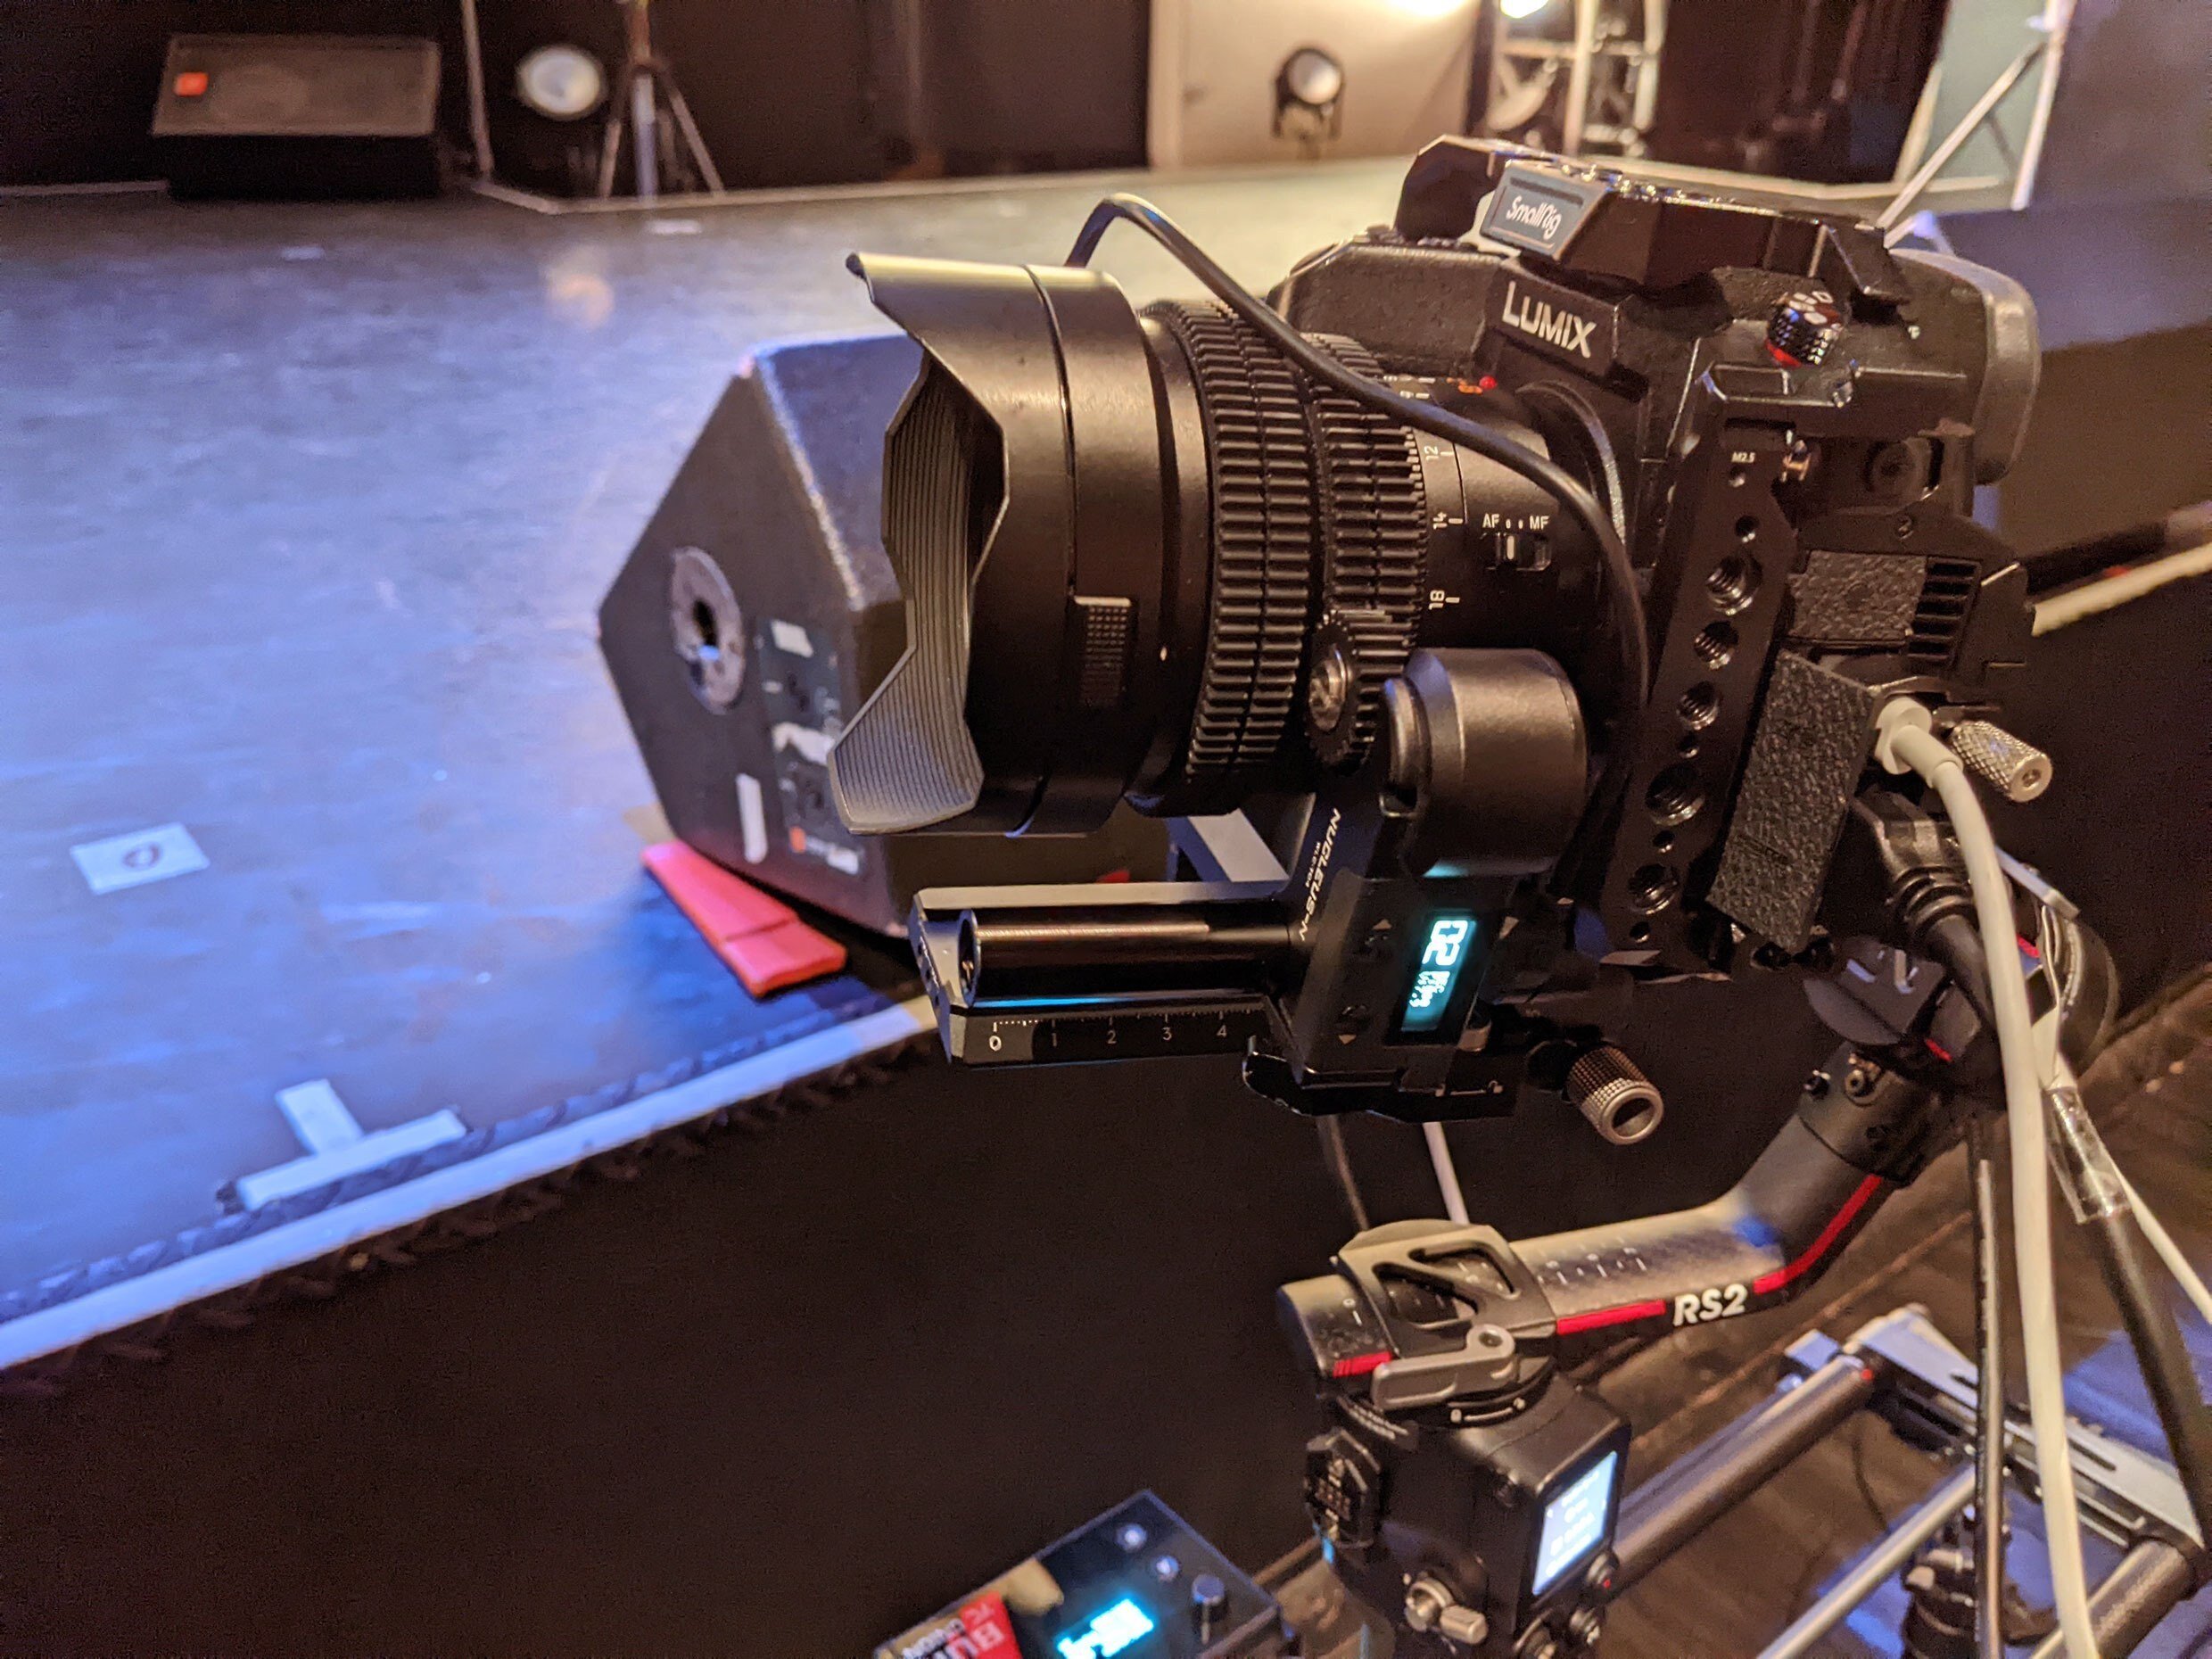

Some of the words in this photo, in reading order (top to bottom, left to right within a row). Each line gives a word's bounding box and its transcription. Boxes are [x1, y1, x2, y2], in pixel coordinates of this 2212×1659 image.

[1506, 194, 1563, 241] SmallRig
[1501, 280, 1597, 359] LUMIX
[1424, 445, 1440, 461] 12
[1730, 451, 1756, 464] M2.5
[1432, 511, 1448, 530] 14
[1482, 513, 1500, 528] AF
[1529, 515, 1550, 530] MF
[1428, 590, 1446, 611] 18
[1421, 920, 1469, 966] 02
[988, 1035, 1003, 1052] 0
[1052, 1032, 1058, 1048] 1
[1107, 1029, 1118, 1044] 2
[1162, 1027, 1173, 1042] 3
[1216, 1024, 1228, 1038] 4
[1672, 1283, 1749, 1327] RS2
